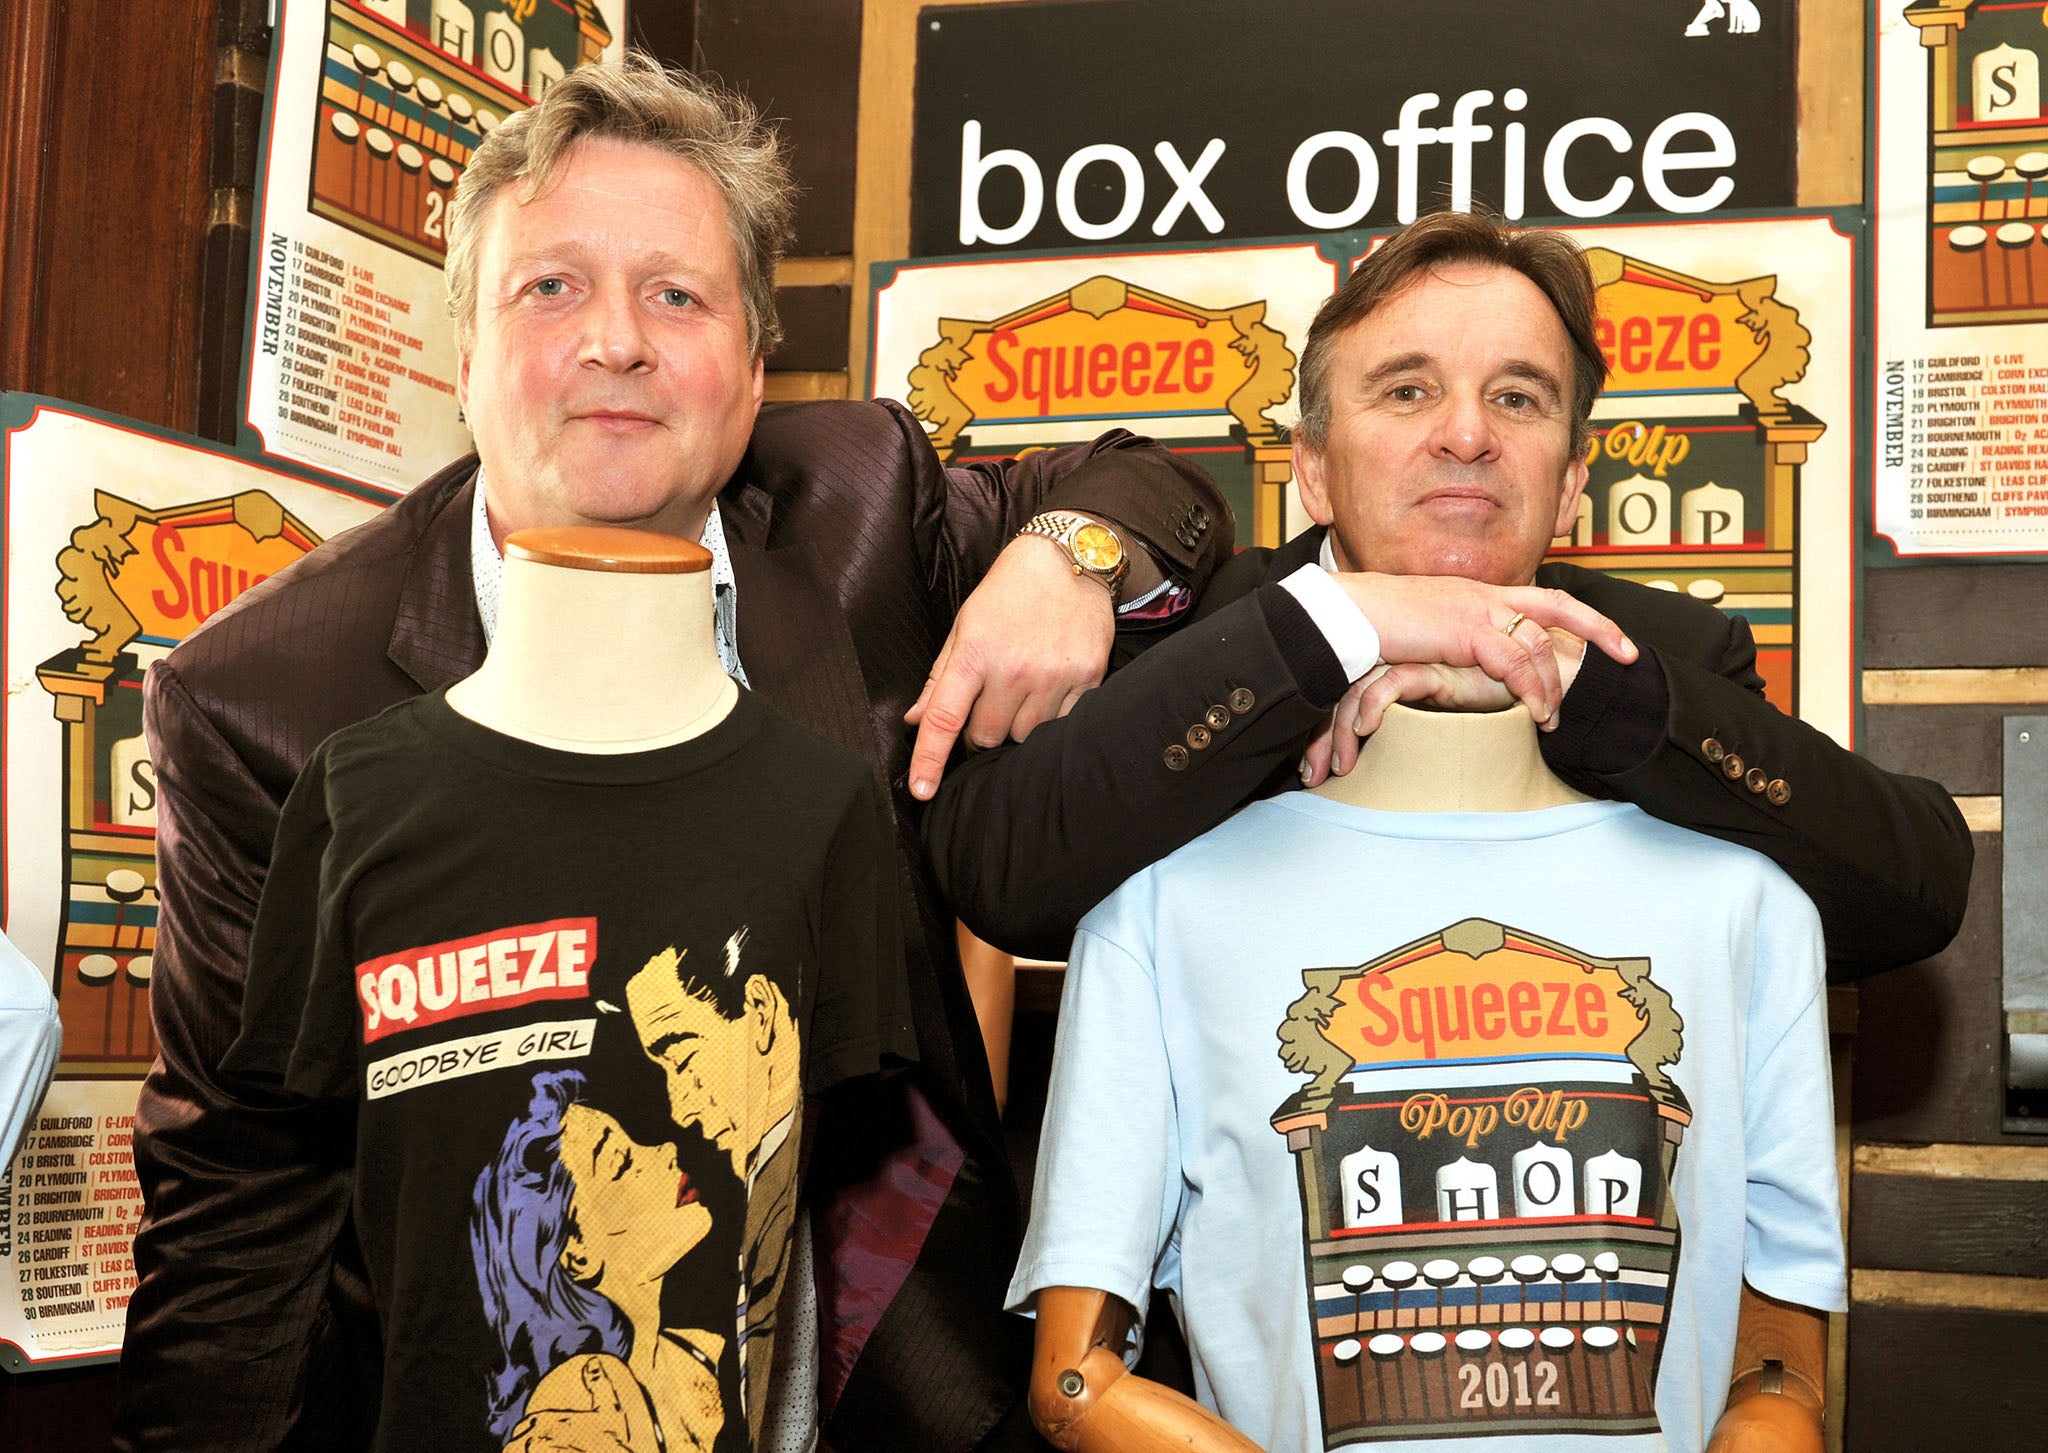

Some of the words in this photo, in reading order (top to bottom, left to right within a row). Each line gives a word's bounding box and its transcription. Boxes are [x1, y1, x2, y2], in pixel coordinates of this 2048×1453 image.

[1989, 61, 2017, 113] S
[959, 119, 1227, 246] box
[1286, 88, 1738, 231] office
[305, 245, 344, 271] GUILDFORD
[353, 265, 374, 283] G-LIVE
[262, 232, 288, 356] NOVEMBER
[291, 274, 301, 287] 19
[303, 278, 332, 299] BRISTOL
[342, 294, 373, 315] COLSTON
[375, 308, 391, 323] HALL
[293, 258, 302, 270] 17
[304, 262, 345, 288] CAMBRIDGE
[355, 283, 374, 299] CORN
[376, 291, 410, 314] EXCHANGE
[287, 307, 297, 319] 21
[300, 311, 336, 334] BRIGHTON
[345, 328, 380, 350] BRIGHTON
[381, 342, 401, 359] DOME
[288, 290, 299, 303] 20
[301, 294, 341, 319] PLYMOUTH
[350, 313, 387, 337] PLYMOUTH
[389, 329, 423, 351] PAVILIONS
[284, 340, 294, 353] 24
[296, 344, 328, 365] READING
[337, 359, 367, 379] READING
[285, 323, 296, 336] 23
[298, 328, 353, 357] BOURNEMOUTH
[374, 357, 407, 377] ACADEMY
[1913, 359, 1924, 369] 16
[1928, 356, 1980, 369] GUILDFORD
[1994, 354, 2024, 365] G-LIVE
[282, 356, 292, 370] 26
[294, 361, 324, 380] CARDIFF
[334, 374, 343, 387] ST
[345, 379, 370, 397] DAVIDS
[371, 388, 388, 404] HALL
[984, 329, 1214, 416] Squeeze
[1913, 374, 1924, 384] 17
[1928, 371, 1983, 383] CAMBRIDGE
[1998, 369, 2025, 380] CORN
[2028, 368, 2048, 379] EXC
[1913, 389, 1924, 398] 19
[1928, 387, 1966, 398] BRISTOL
[1981, 385, 2026, 396] COLSTON
[279, 390, 289, 403] 28
[291, 394, 330, 416] SOUTHEND
[339, 410, 361, 427] CLIFFS
[363, 418, 394, 438] PAVILION
[280, 373, 291, 386] 27
[292, 377, 339, 402] FOLKESTONE
[365, 402, 383, 418] CLIFF
[385, 409, 402, 425] HALL
[1886, 360, 1904, 468] NOVEMBER
[1912, 404, 1924, 413] 20
[1928, 401, 1980, 412] PLYMOUTH
[1994, 399, 2047, 410] PLYMOUTH
[278, 406, 288, 419] 30
[290, 410, 338, 435] BIRMINGHAM
[347, 429, 384, 451] SYMPHONY
[386, 443, 402, 458] HALL
[1912, 418, 1923, 428] 21
[1928, 416, 1976, 428] BRIGHTON
[1990, 414, 2038, 425] BRIGHTON
[1912, 434, 1923, 443] 23
[1927, 431, 2001, 442] BOURNEMOUTH
[1605, 421, 1690, 477] Up
[1911, 449, 1923, 458] 24
[1927, 447, 1968, 457] READING
[1982, 445, 2024, 456] READING
[1911, 464, 1923, 473] 26
[1927, 462, 1965, 473] CARDIFF
[1980, 461, 1991, 471] ST
[1996, 460, 2031, 471] DAVIDS
[1911, 478, 1923, 488] 27
[1927, 477, 1986, 488] FOLKESTONE
[2001, 475, 2024, 486] LEAS
[1911, 493, 1923, 504] 28
[1927, 493, 1978, 503] SOUTHEND
[1992, 491, 2023, 502] CLIFFS
[1911, 509, 1923, 519] 30
[1927, 507, 1991, 519] BIRMINGHAM
[152, 523, 269, 624] Squ
[360, 928, 587, 1030] SQUEEZE
[1357, 974, 1609, 1059] Squeeze
[371, 1041, 502, 1092] GOODBYE
[517, 1030, 588, 1057] GIRL
[40, 1116, 93, 1131] GUILDFORD
[1401, 1093, 1498, 1148] Pop
[1504, 1087, 1589, 1142] Up
[21, 1156, 34, 1169] 19
[36, 1154, 76, 1168] BRISTOL
[89, 1152, 133, 1166] COLSTON
[38, 1134, 95, 1149] CAMBRIDGE
[18, 1194, 30, 1207] 21
[34, 1190, 82, 1206] BRIGHTON
[93, 1187, 141, 1202] BRIGHTON
[19, 1174, 32, 1188] 20
[35, 1171, 87, 1187] PLYMOUTH
[1357, 1161, 1629, 1221] SHOP
[17, 1212, 30, 1226] 23
[33, 1207, 104, 1225] BOURNEMOUTH
[18, 1232, 30, 1245] 24
[33, 1227, 72, 1243] READING
[84, 1224, 123, 1239] READING
[126, 1222, 138, 1235] HE
[18, 1250, 31, 1264] 26
[33, 1246, 70, 1262] CARDIFF
[82, 1244, 94, 1257] ST
[96, 1241, 129, 1256] DAVIDS
[19, 1269, 31, 1283] 27
[34, 1263, 89, 1281] FOLKESTONE
[100, 1259, 122, 1274] LEAS
[21, 1288, 34, 1301] 28
[36, 1282, 82, 1300] SOUTHEND
[93, 1278, 121, 1293] CLIFFS
[24, 1307, 37, 1320] 30
[38, 1300, 95, 1318] BIRMINGHAM
[1458, 1360, 1560, 1409] 2012
